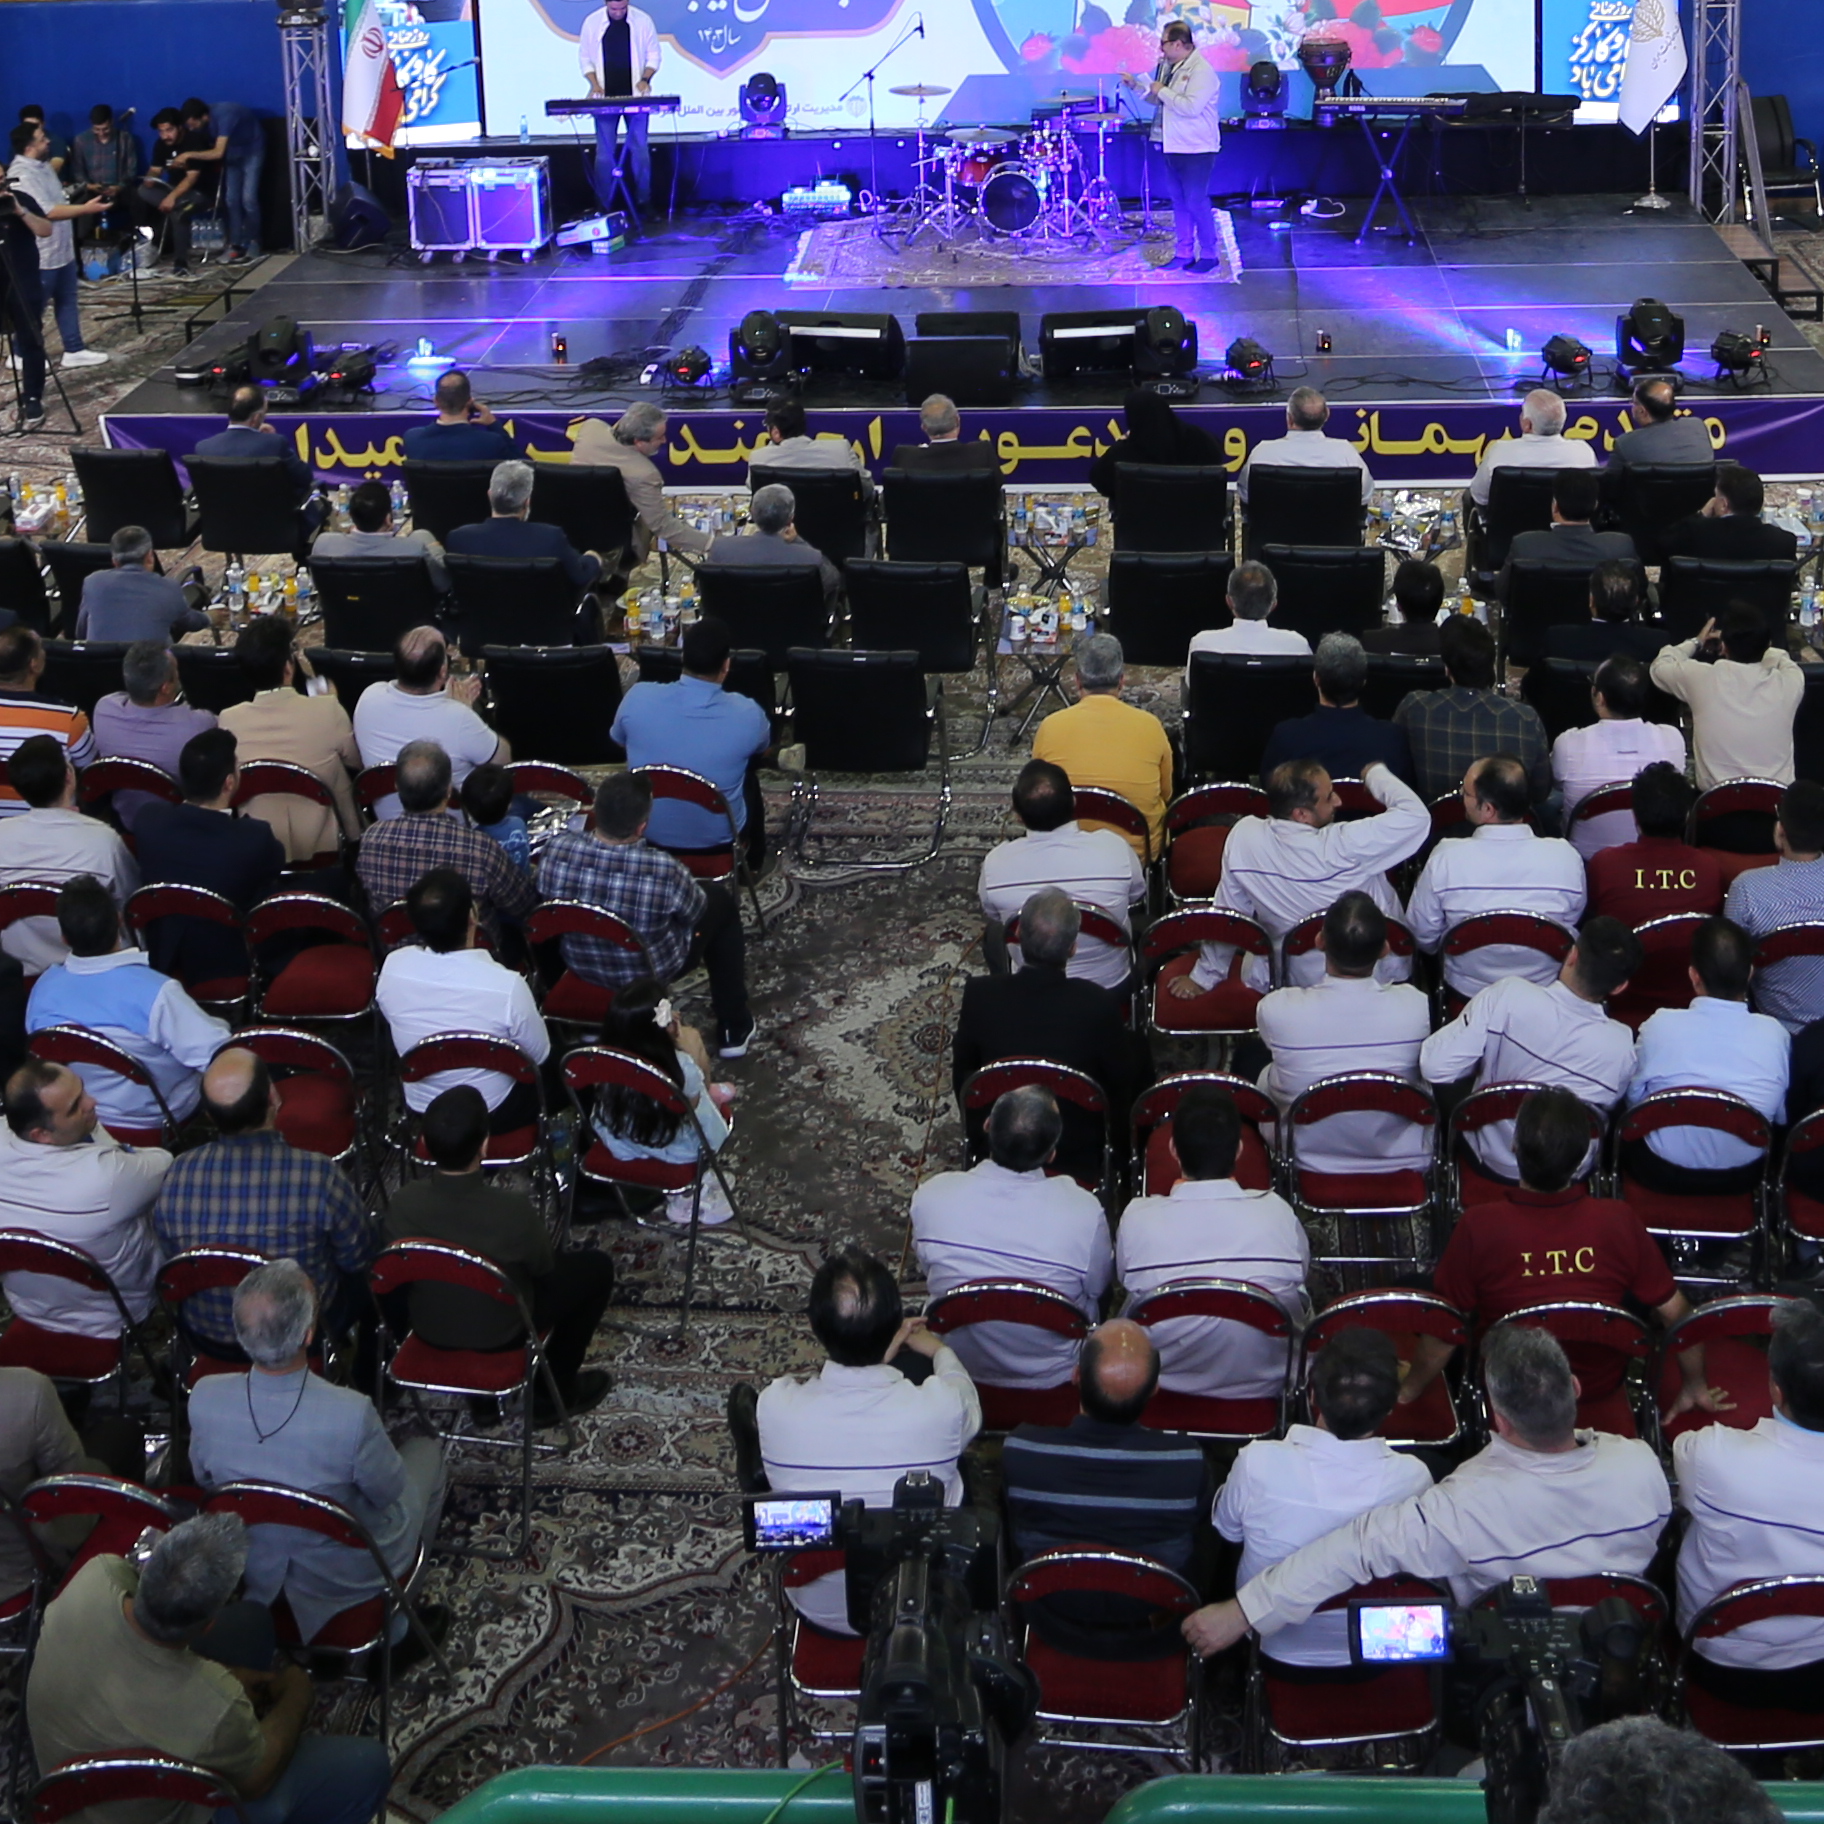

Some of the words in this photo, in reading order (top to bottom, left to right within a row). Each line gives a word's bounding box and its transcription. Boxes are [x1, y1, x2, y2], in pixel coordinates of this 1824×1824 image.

[1613, 1, 1633, 16] روز
[710, 24, 741, 54] سال
[1224, 427, 1247, 473] و
[1634, 869, 1697, 889] I.T.C
[1521, 1247, 1595, 1277] I.T.C
